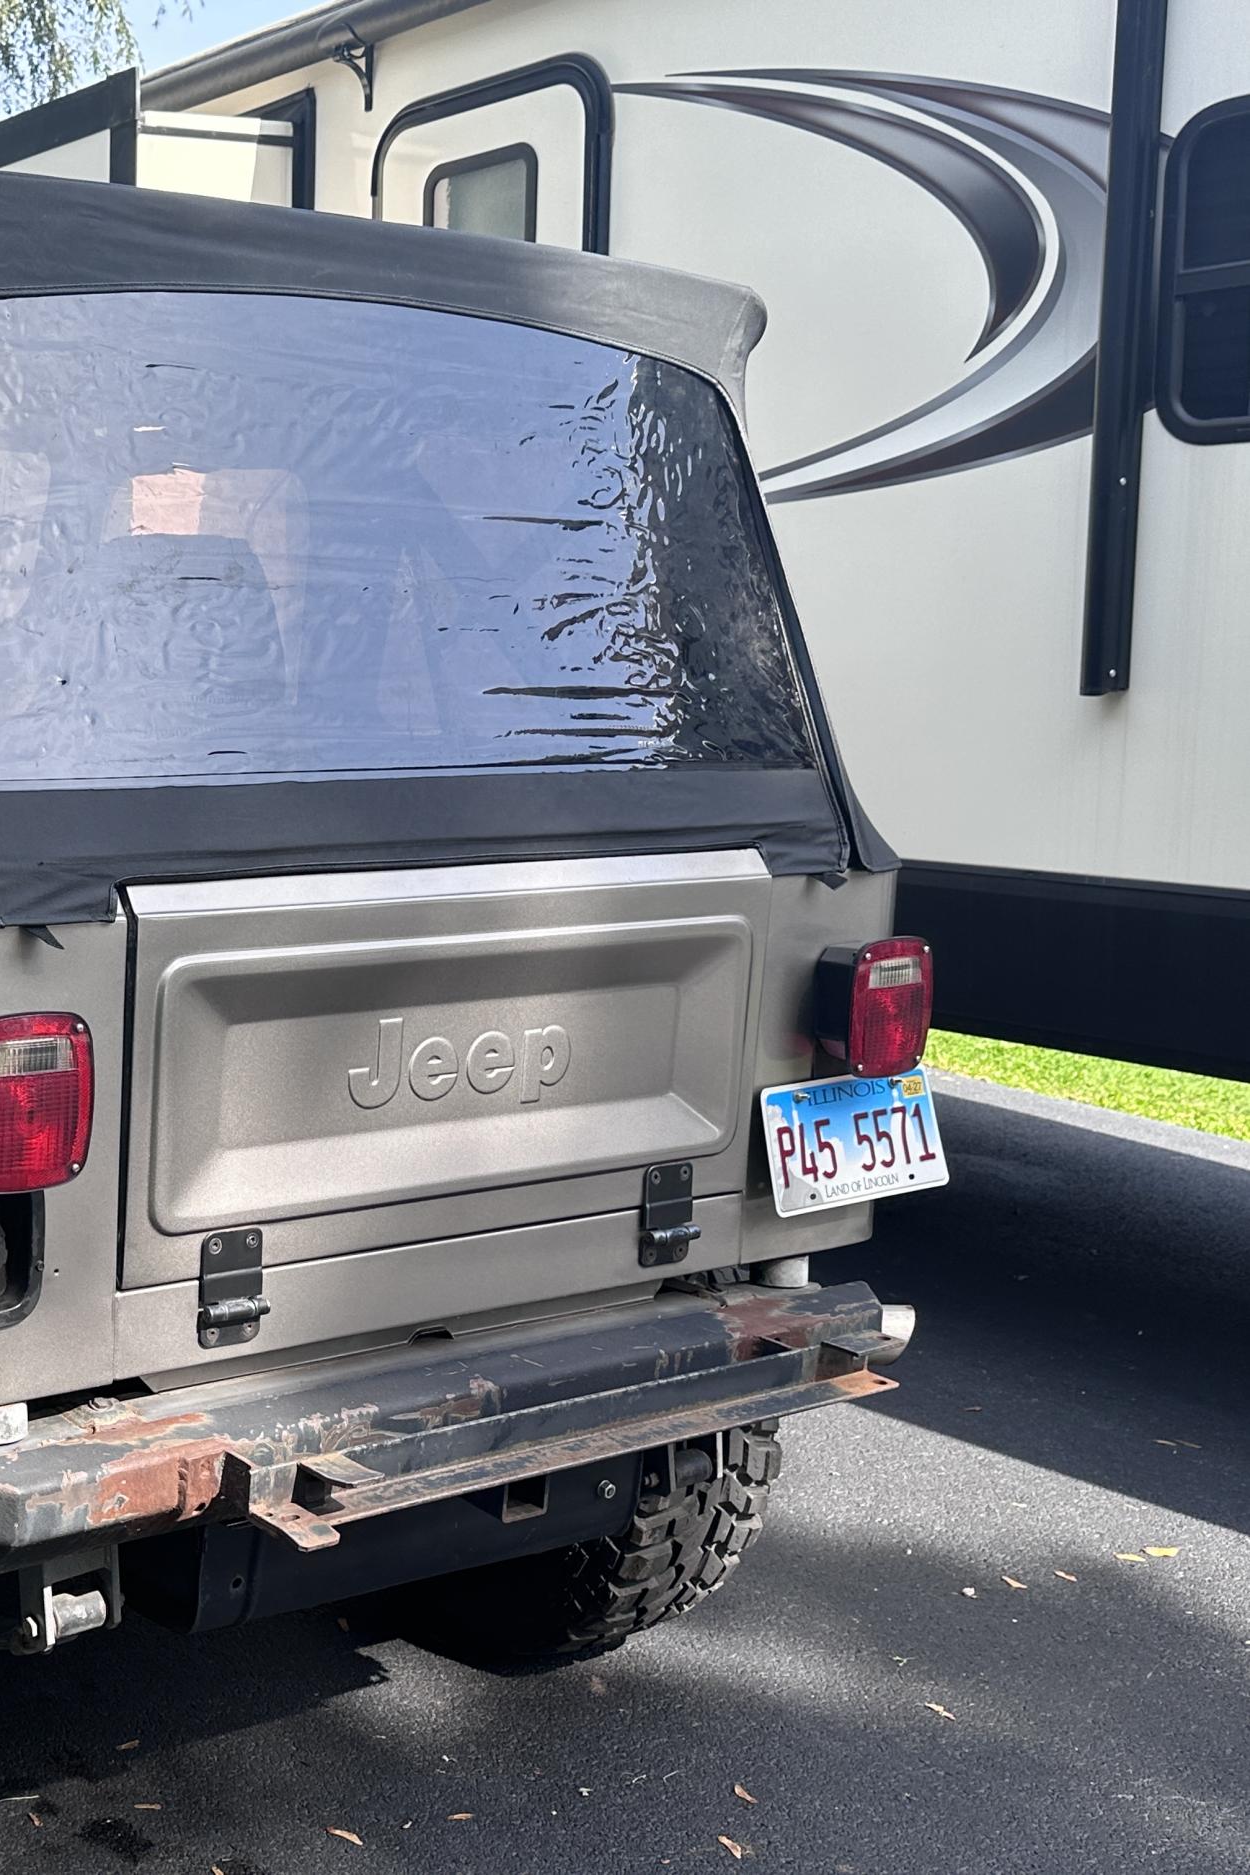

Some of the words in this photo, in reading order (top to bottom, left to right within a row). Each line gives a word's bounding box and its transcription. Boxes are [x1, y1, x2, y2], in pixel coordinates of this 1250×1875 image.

[348, 1017, 571, 1110] Jeep
[807, 1081, 885, 1106] ILLINOIS
[776, 1118, 838, 1189] P45
[853, 1102, 936, 1171] 5571
[825, 1183, 850, 1198] LAND
[863, 1173, 899, 1190] LINCOLN
